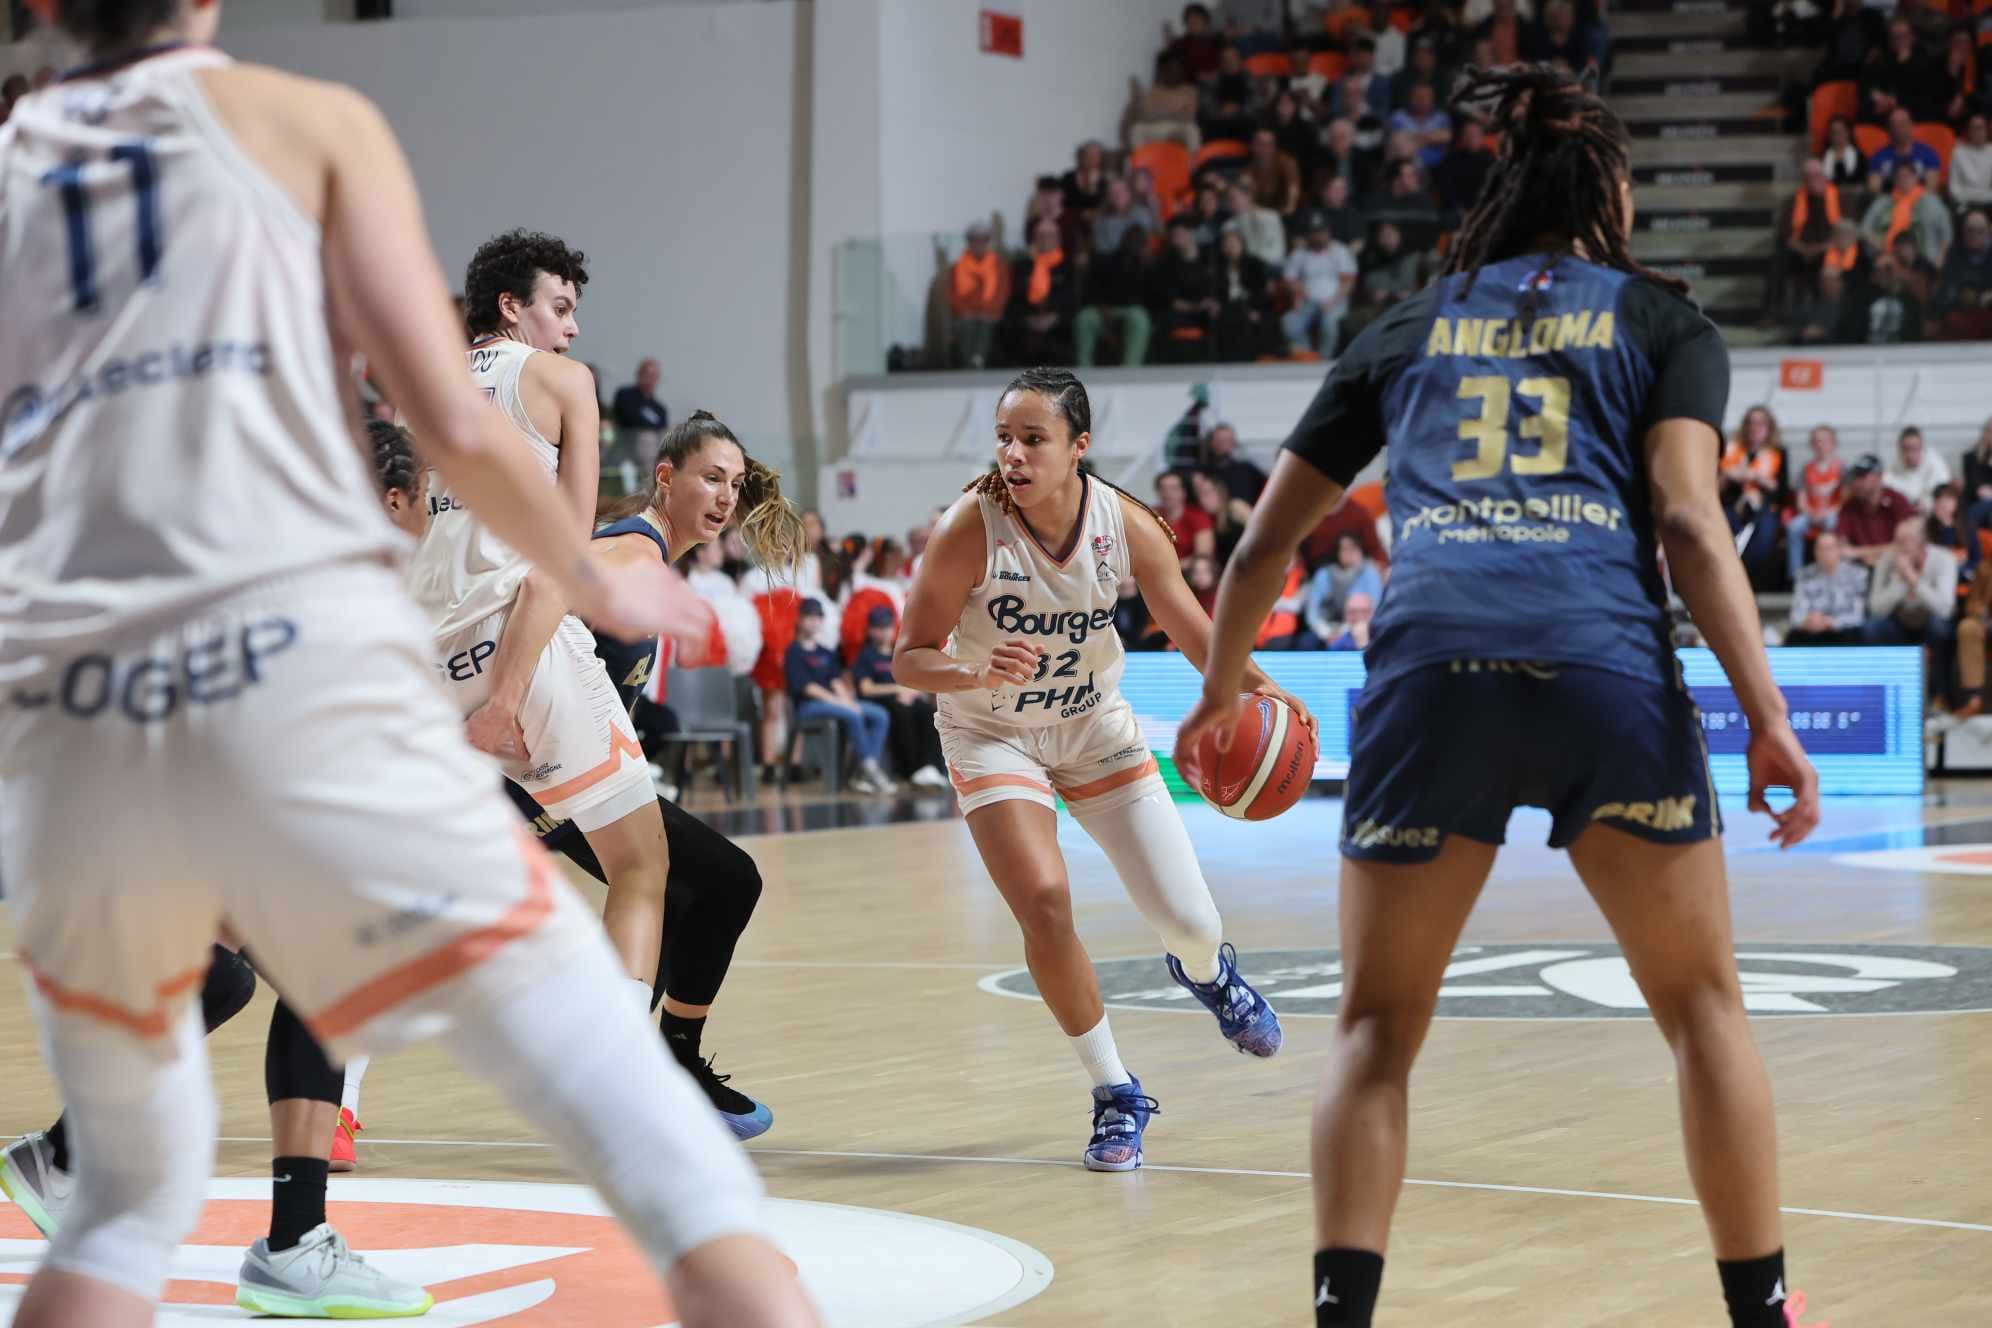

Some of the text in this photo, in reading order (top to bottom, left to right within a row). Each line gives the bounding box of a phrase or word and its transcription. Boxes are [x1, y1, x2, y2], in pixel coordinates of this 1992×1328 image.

[1427, 310, 1615, 357] ANGLOMA
[1452, 374, 1572, 481] 33
[1061, 692, 1102, 719] GROUP
[1277, 741, 1304, 794] molten
